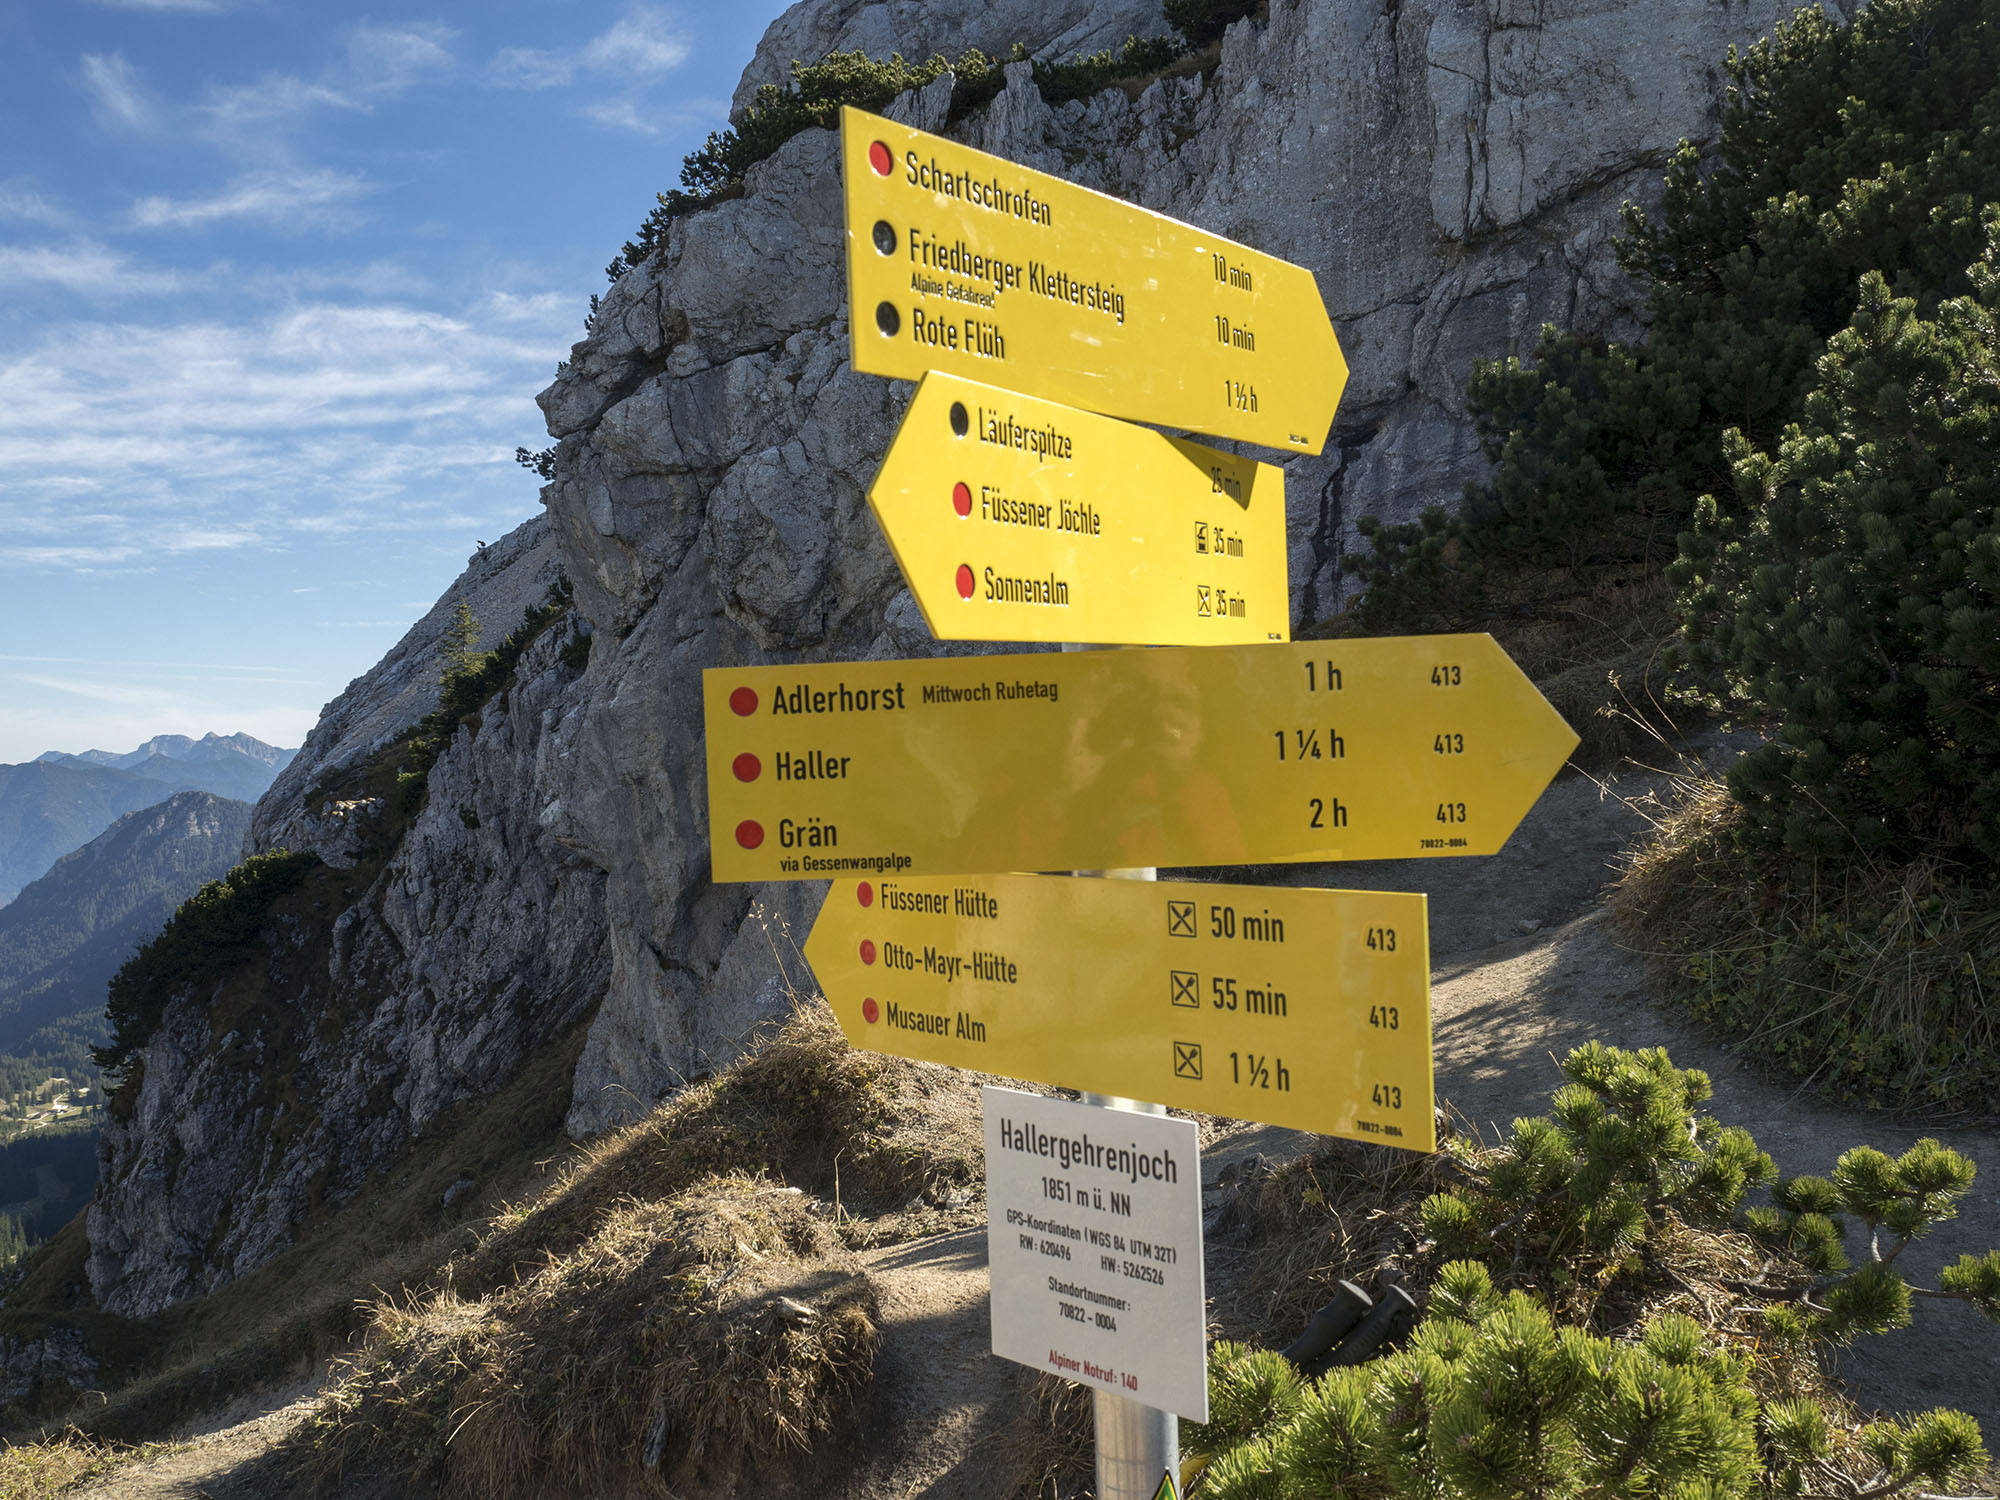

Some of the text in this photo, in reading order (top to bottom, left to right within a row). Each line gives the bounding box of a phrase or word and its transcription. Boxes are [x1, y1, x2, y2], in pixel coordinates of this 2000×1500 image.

[907, 151, 1051, 226] Schartschrofen
[910, 228, 1124, 324] Friedberger Klettersteig
[1213, 254, 1252, 291] 10 min
[914, 308, 1005, 359] Rote Flüh
[1216, 316, 1255, 351] 10 min
[979, 407, 1072, 462] Läuferspitze
[1211, 466, 1241, 500] 25 min
[982, 486, 1100, 535] Füssener Jöchle
[1214, 527, 1243, 558] 35 min
[984, 566, 1069, 606] Sonnenalm
[1216, 589, 1245, 618] 35 min
[1305, 661, 1342, 691] 1 h
[1431, 666, 1461, 686] 413
[773, 681, 1058, 715] Adlerhorst Mittwoch Ruhetag
[1434, 734, 1464, 754] 413
[776, 750, 851, 781] Haller
[1309, 798, 1347, 828] 2 h
[1436, 803, 1466, 823] 413
[779, 818, 837, 848] Grän
[780, 853, 912, 872] via Gessenwangalpe
[881, 883, 998, 919] Füssener Hütte
[1211, 906, 1284, 943] 50 min
[1366, 928, 1396, 952] 413
[884, 942, 1017, 984] Otto-Mayr-Hütte
[1213, 977, 1287, 1017] 55 min
[887, 1001, 986, 1043] Musauer Alm
[1369, 1005, 1399, 1030] 413
[1372, 1084, 1402, 1109] 413
[1001, 1118, 1177, 1183] Hallergehrenjoch
[1042, 1177, 1131, 1217] 1851 m ü. NN
[1007, 1208, 1081, 1241] GPS-Koordinaten
[1114, 1235, 1126, 1253] 84
[1130, 1239, 1152, 1260] UTM
[1123, 1260, 1164, 1286] 5262526
[1049, 1349, 1138, 1391] Alpiner Notruf: 140
